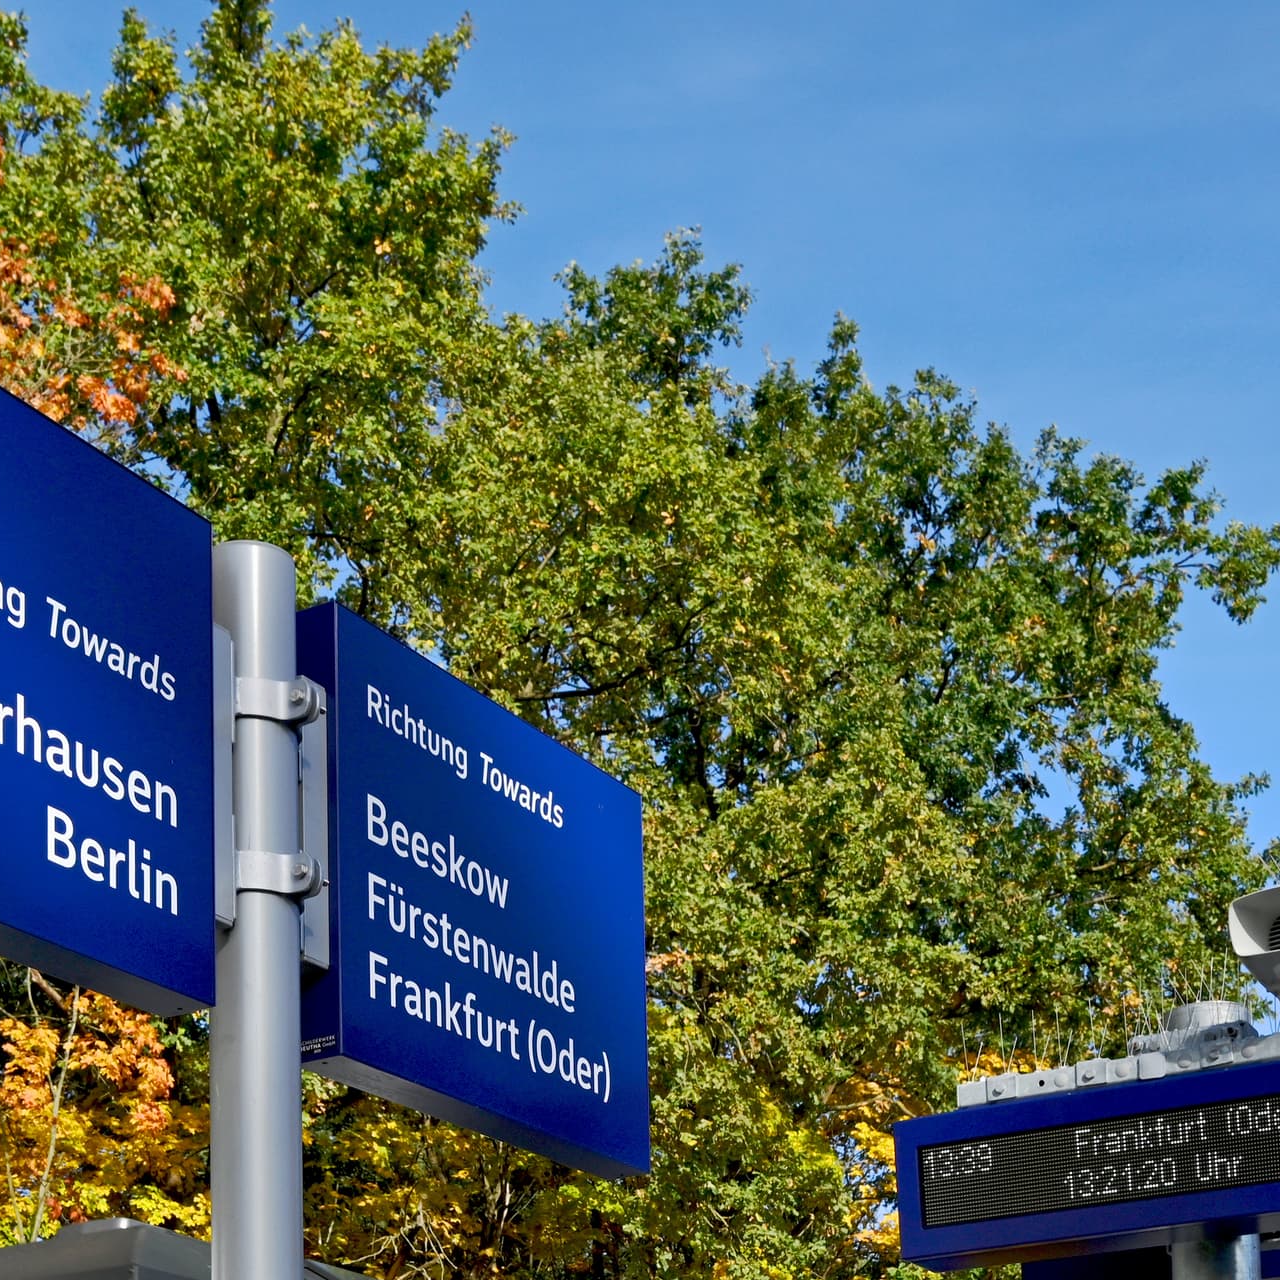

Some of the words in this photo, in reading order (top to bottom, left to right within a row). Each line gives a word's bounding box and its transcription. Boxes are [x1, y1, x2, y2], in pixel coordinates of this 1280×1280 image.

[46, 596, 176, 701] Towards
[367, 684, 468, 780] Richtung
[479, 751, 564, 829] Towards
[47, 804, 178, 916] Berlin
[367, 793, 509, 909] Beeskow
[368, 871, 575, 1013] Fürstenwalde
[369, 950, 520, 1061] Frankfurt
[528, 1019, 611, 1104] (Oder)
[924, 1143, 993, 1179] 13:39
[1075, 1111, 1208, 1158] Frankfurt
[1063, 1157, 1177, 1199] 13:21:20
[1195, 1151, 1243, 1182] Uhr
